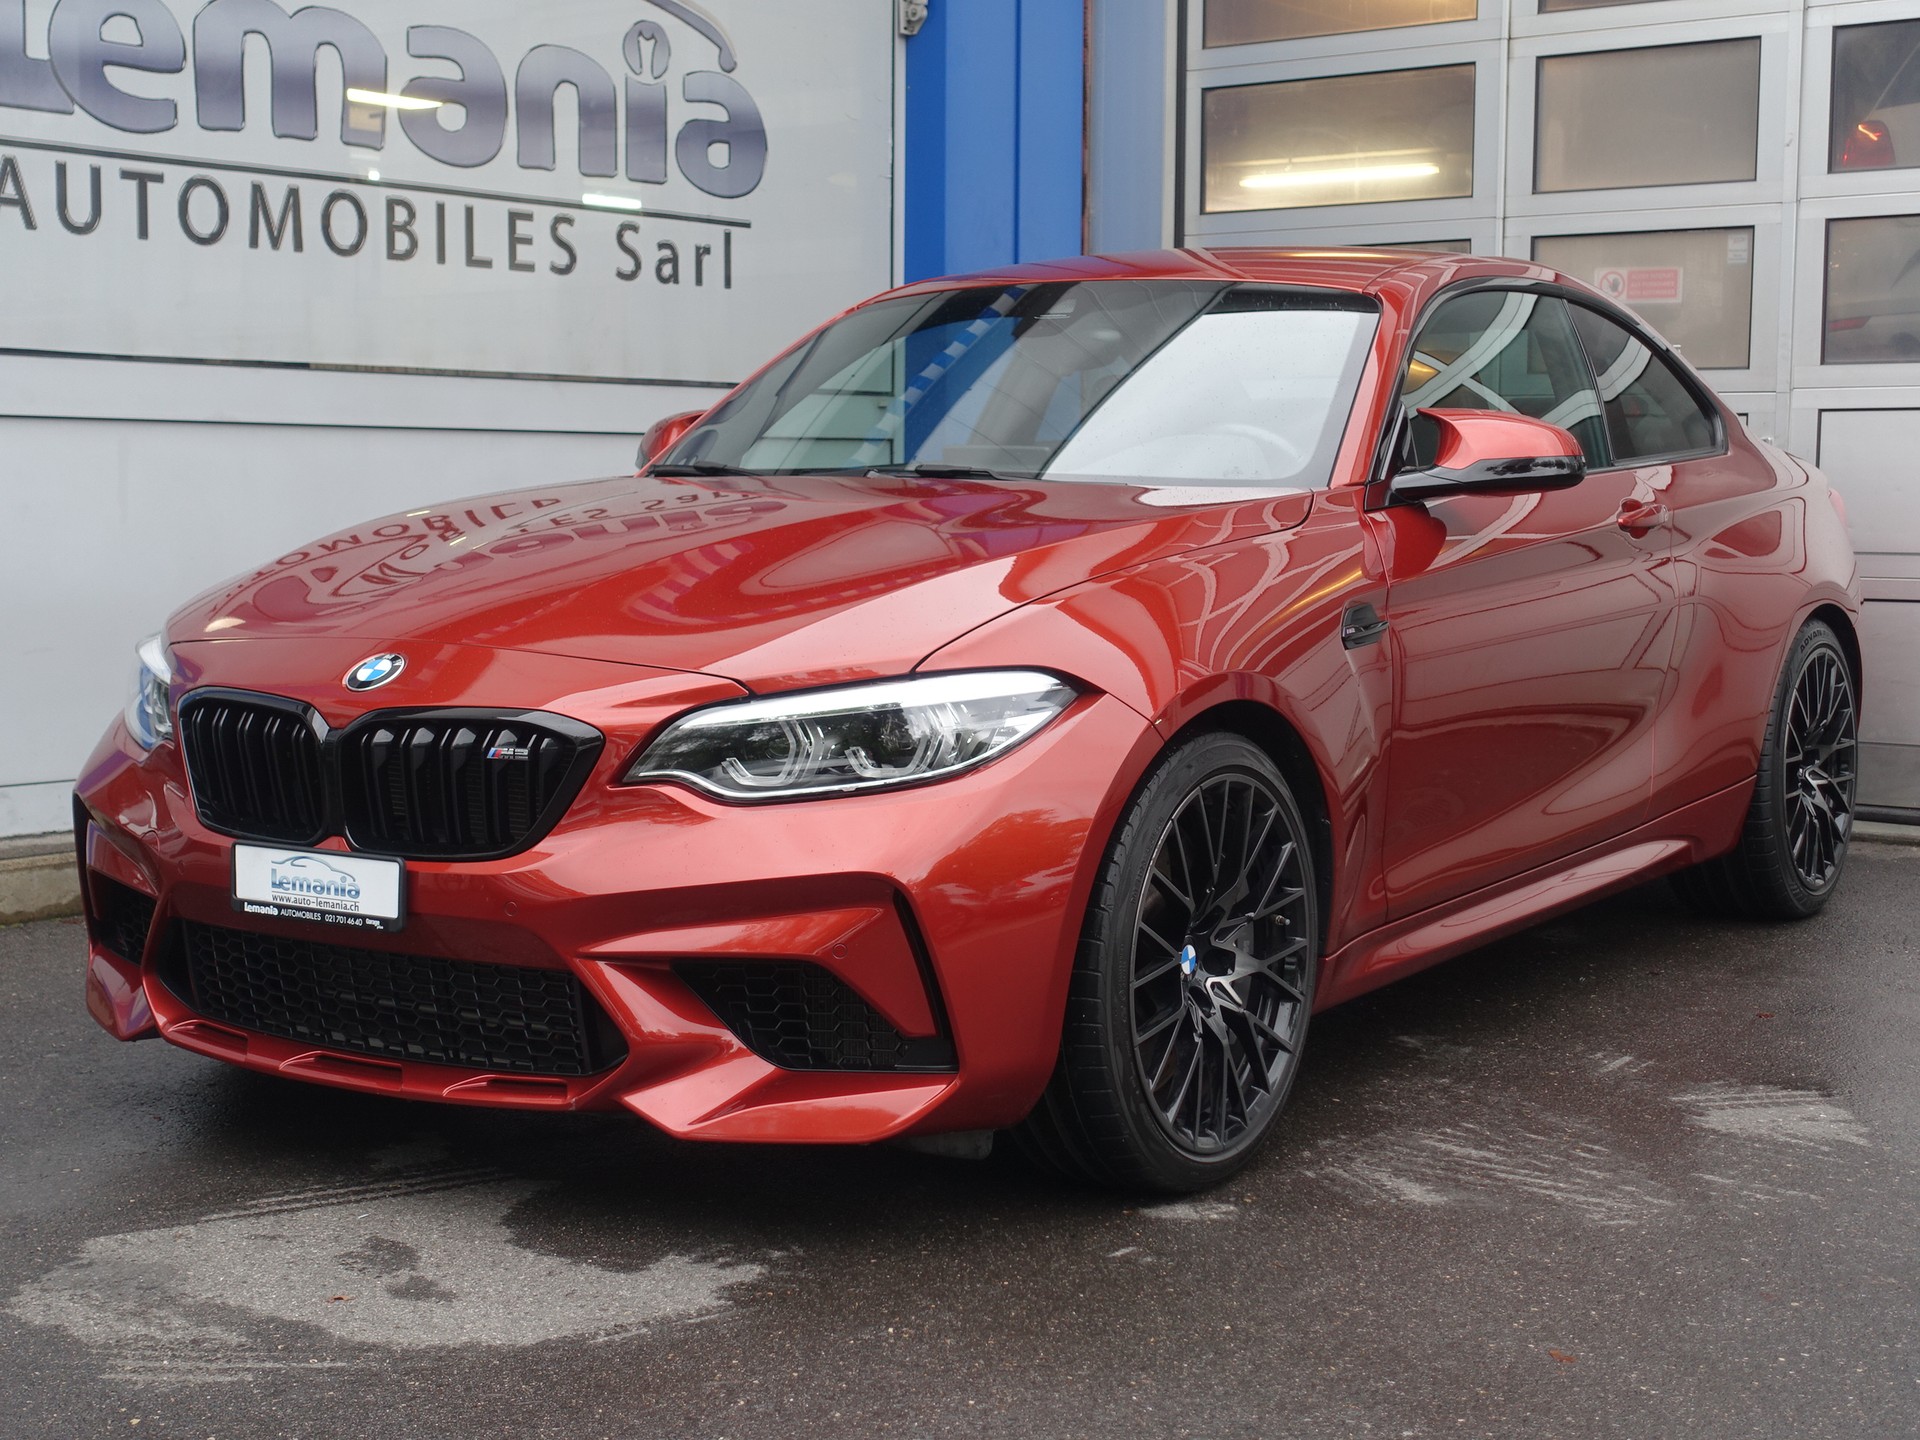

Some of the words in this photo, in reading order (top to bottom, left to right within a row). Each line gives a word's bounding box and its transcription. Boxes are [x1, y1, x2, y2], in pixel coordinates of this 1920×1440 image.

[0, 154, 577, 275] AUTOMOBILES
[615, 220, 732, 289] Sarl
[1800, 629, 1823, 654] ADVAN
[271, 868, 360, 899] Lemania
[244, 901, 279, 916] Lemania
[280, 908, 322, 921] AUTOMOBILES
[272, 894, 360, 912] www.auto-lemania.ch
